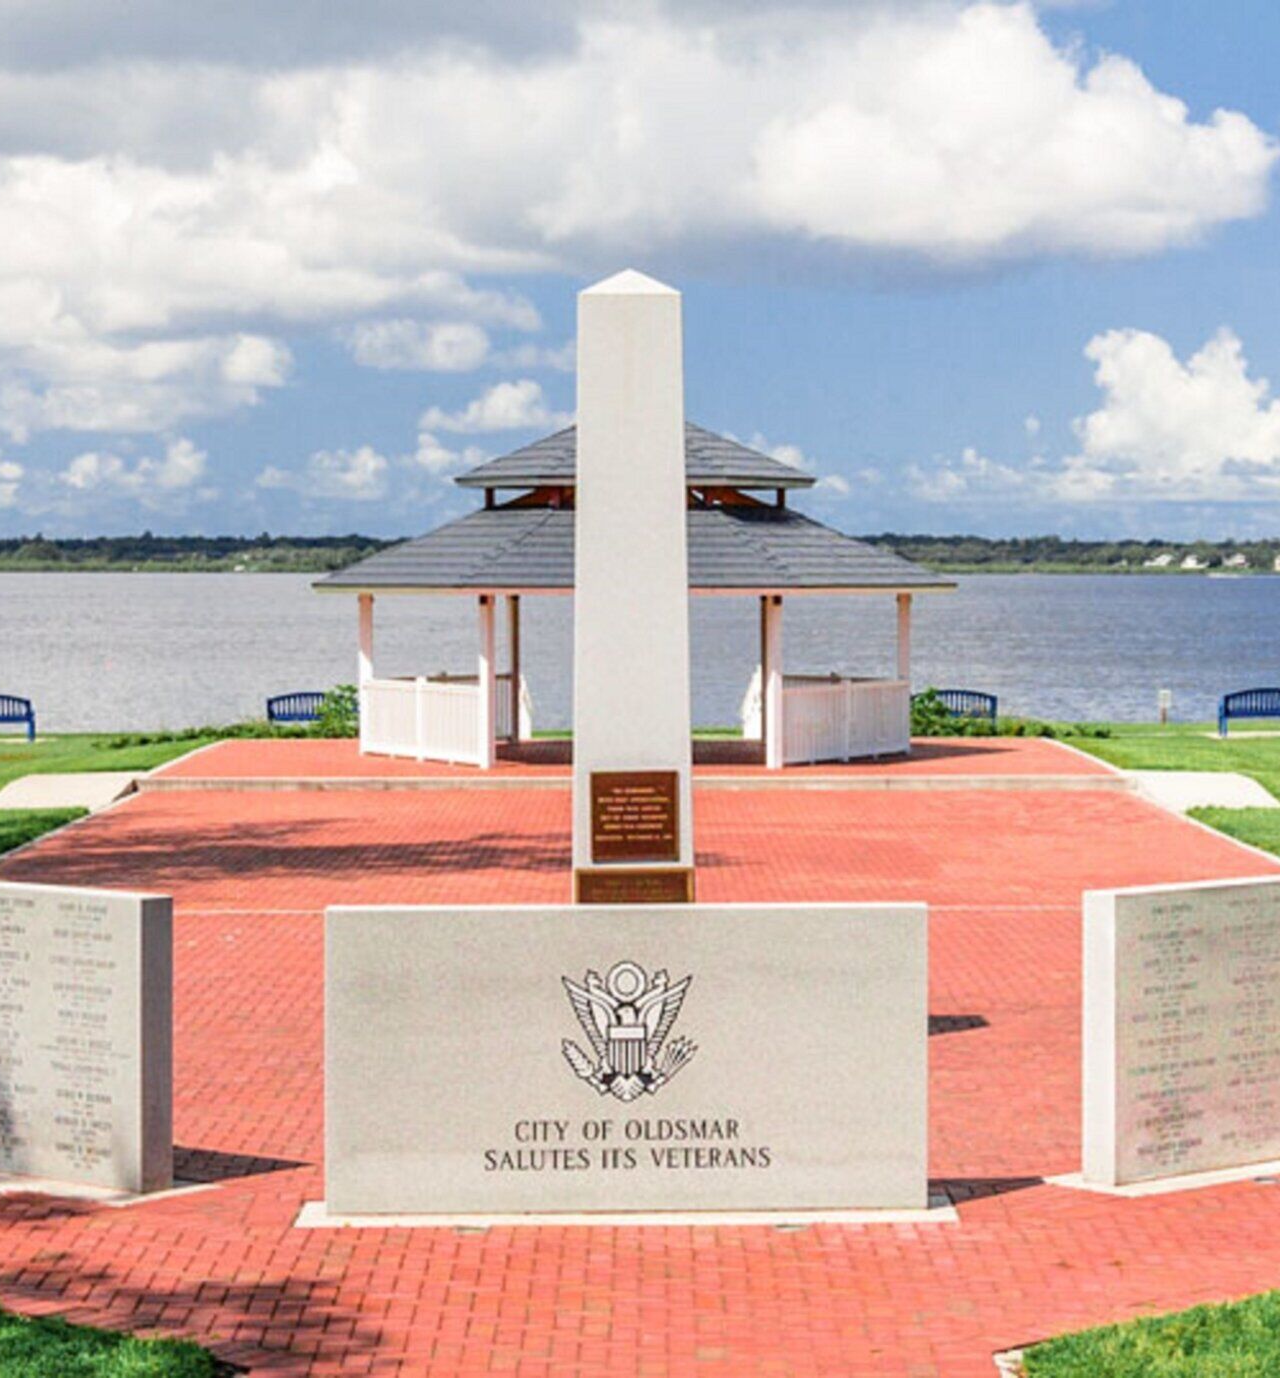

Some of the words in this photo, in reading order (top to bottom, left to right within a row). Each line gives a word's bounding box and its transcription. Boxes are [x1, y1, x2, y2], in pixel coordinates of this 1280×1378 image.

[514, 1120, 570, 1142] CITY
[582, 1120, 614, 1141] OF
[624, 1118, 739, 1140] OLDSMAR
[484, 1148, 590, 1171] SALUTES
[600, 1148, 637, 1170] ITS
[651, 1146, 771, 1170] VETERANS
